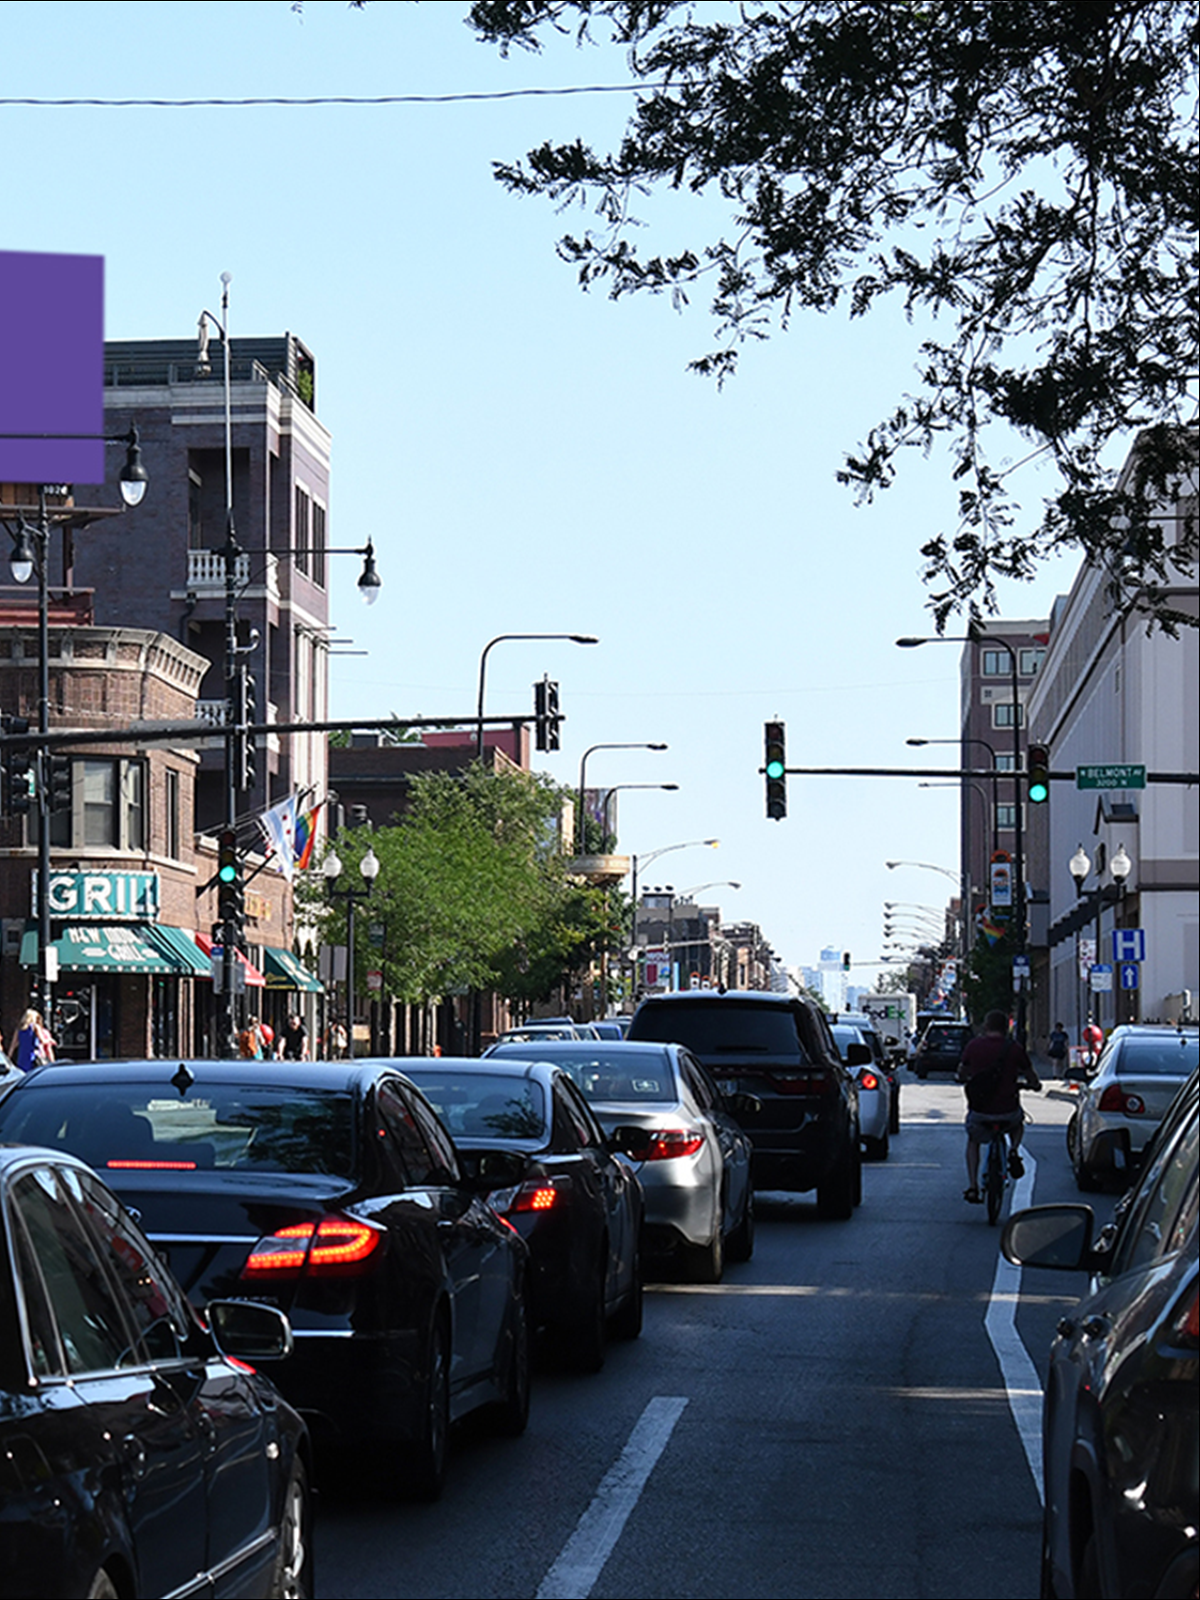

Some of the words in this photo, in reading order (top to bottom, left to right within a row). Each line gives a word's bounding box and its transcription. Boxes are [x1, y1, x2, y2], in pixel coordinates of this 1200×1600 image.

[1088, 767, 1132, 778] BELMONT
[48, 876, 157, 914] GRILL
[1117, 930, 1140, 960] H
